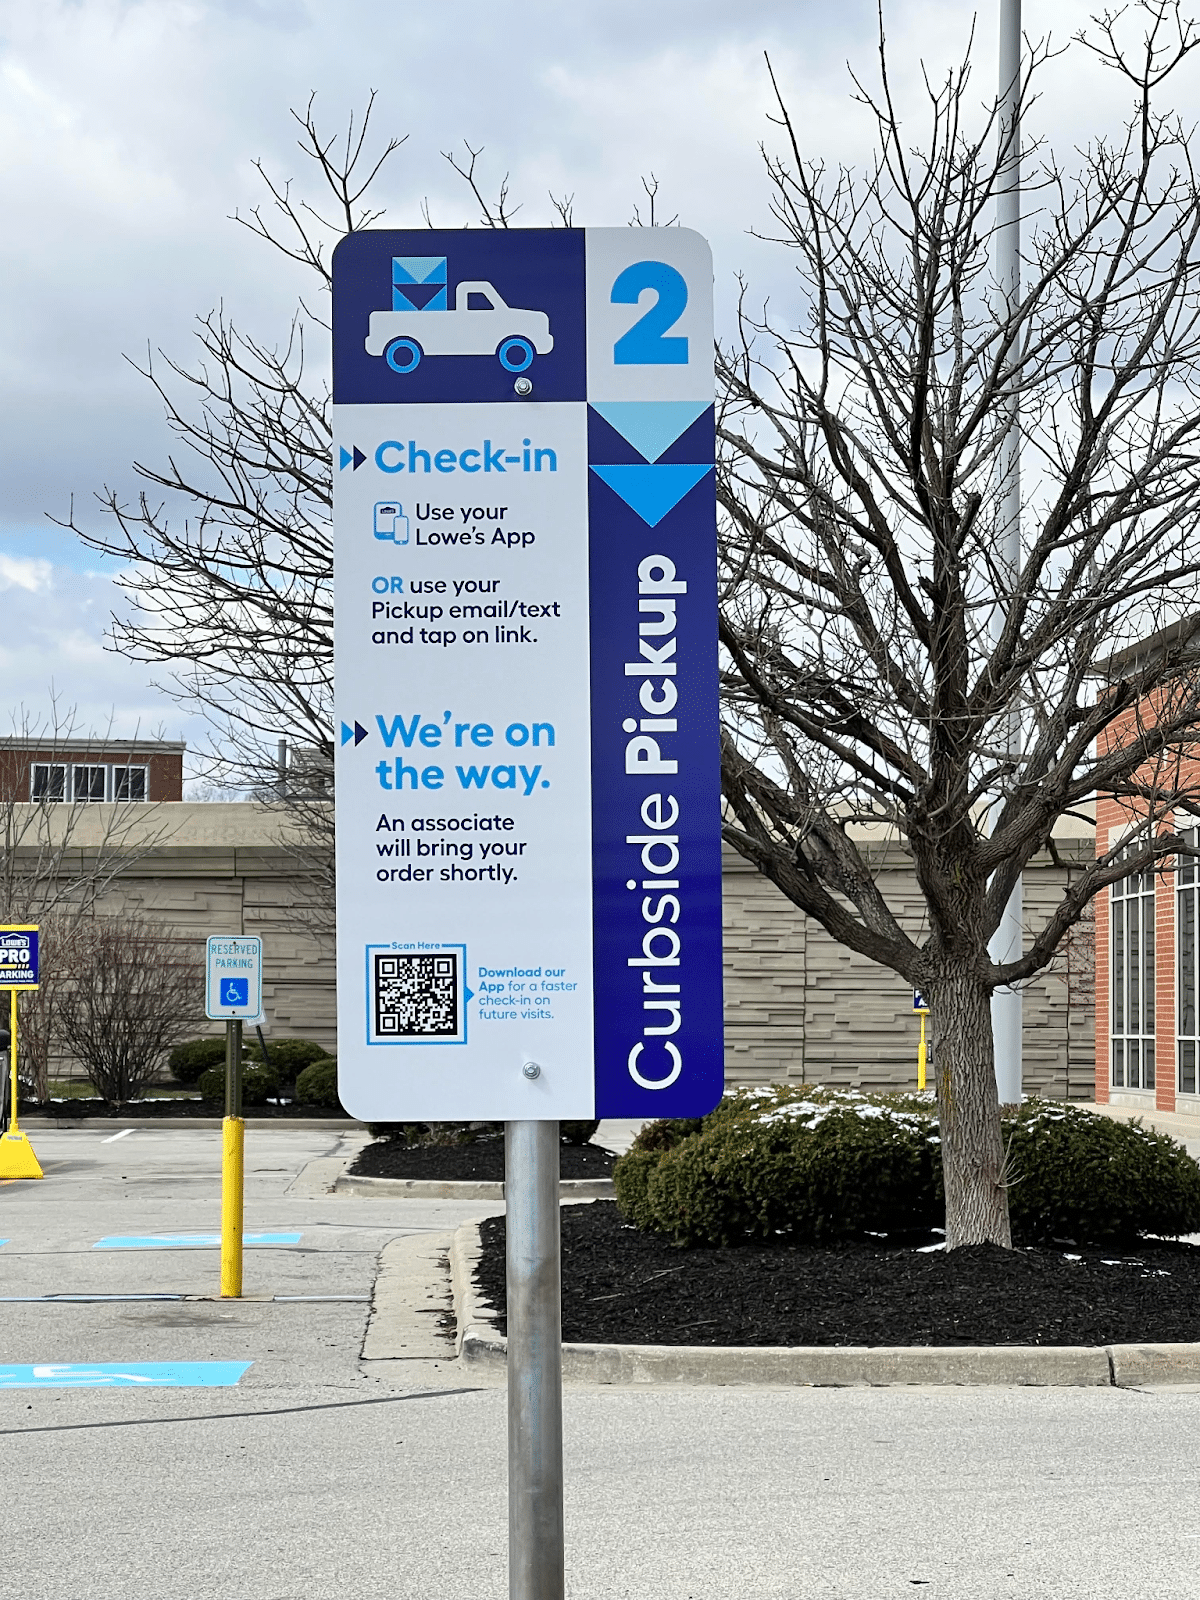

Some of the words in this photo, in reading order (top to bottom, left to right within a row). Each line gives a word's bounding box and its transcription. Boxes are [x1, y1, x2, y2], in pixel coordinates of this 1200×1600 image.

[610, 260, 688, 365] 2
[375, 438, 557, 473] Check-in
[416, 503, 454, 520] Use
[461, 505, 508, 523] your
[416, 526, 485, 545] Lowe’s
[491, 528, 535, 548] App
[372, 576, 403, 594] OR
[410, 580, 446, 593] use
[453, 579, 500, 596] your
[372, 601, 443, 621] Pickup
[449, 600, 561, 618] email/text
[372, 627, 413, 644] and
[420, 628, 456, 647] tap
[463, 630, 488, 643] on
[495, 626, 537, 643] link.
[622, 553, 688, 774] Pickup
[375, 710, 494, 748] We’re
[506, 722, 555, 747] on
[376, 757, 444, 790] the
[455, 765, 550, 796] way.
[376, 814, 404, 831] An
[411, 814, 515, 831] associate
[376, 839, 410, 857] will
[417, 839, 473, 860] bring
[479, 842, 527, 859] your
[376, 864, 434, 881] order
[440, 864, 517, 884] shortly.
[211, 945, 257, 954] RESERVED
[392, 942, 415, 950] Scan
[417, 942, 440, 950] Here
[627, 792, 683, 1090] Curbside
[0, 949, 30, 963] PRO
[216, 959, 253, 968] PARKING
[0, 970, 34, 979] ARKING
[479, 967, 541, 977] Download
[545, 969, 565, 977] our
[479, 981, 505, 994] App
[508, 981, 525, 991] for
[529, 982, 537, 991] a
[541, 980, 577, 991] faster
[479, 995, 530, 1006] check-in
[535, 996, 550, 1005] on
[479, 1009, 517, 1020] future
[521, 1009, 554, 1019] visits.
